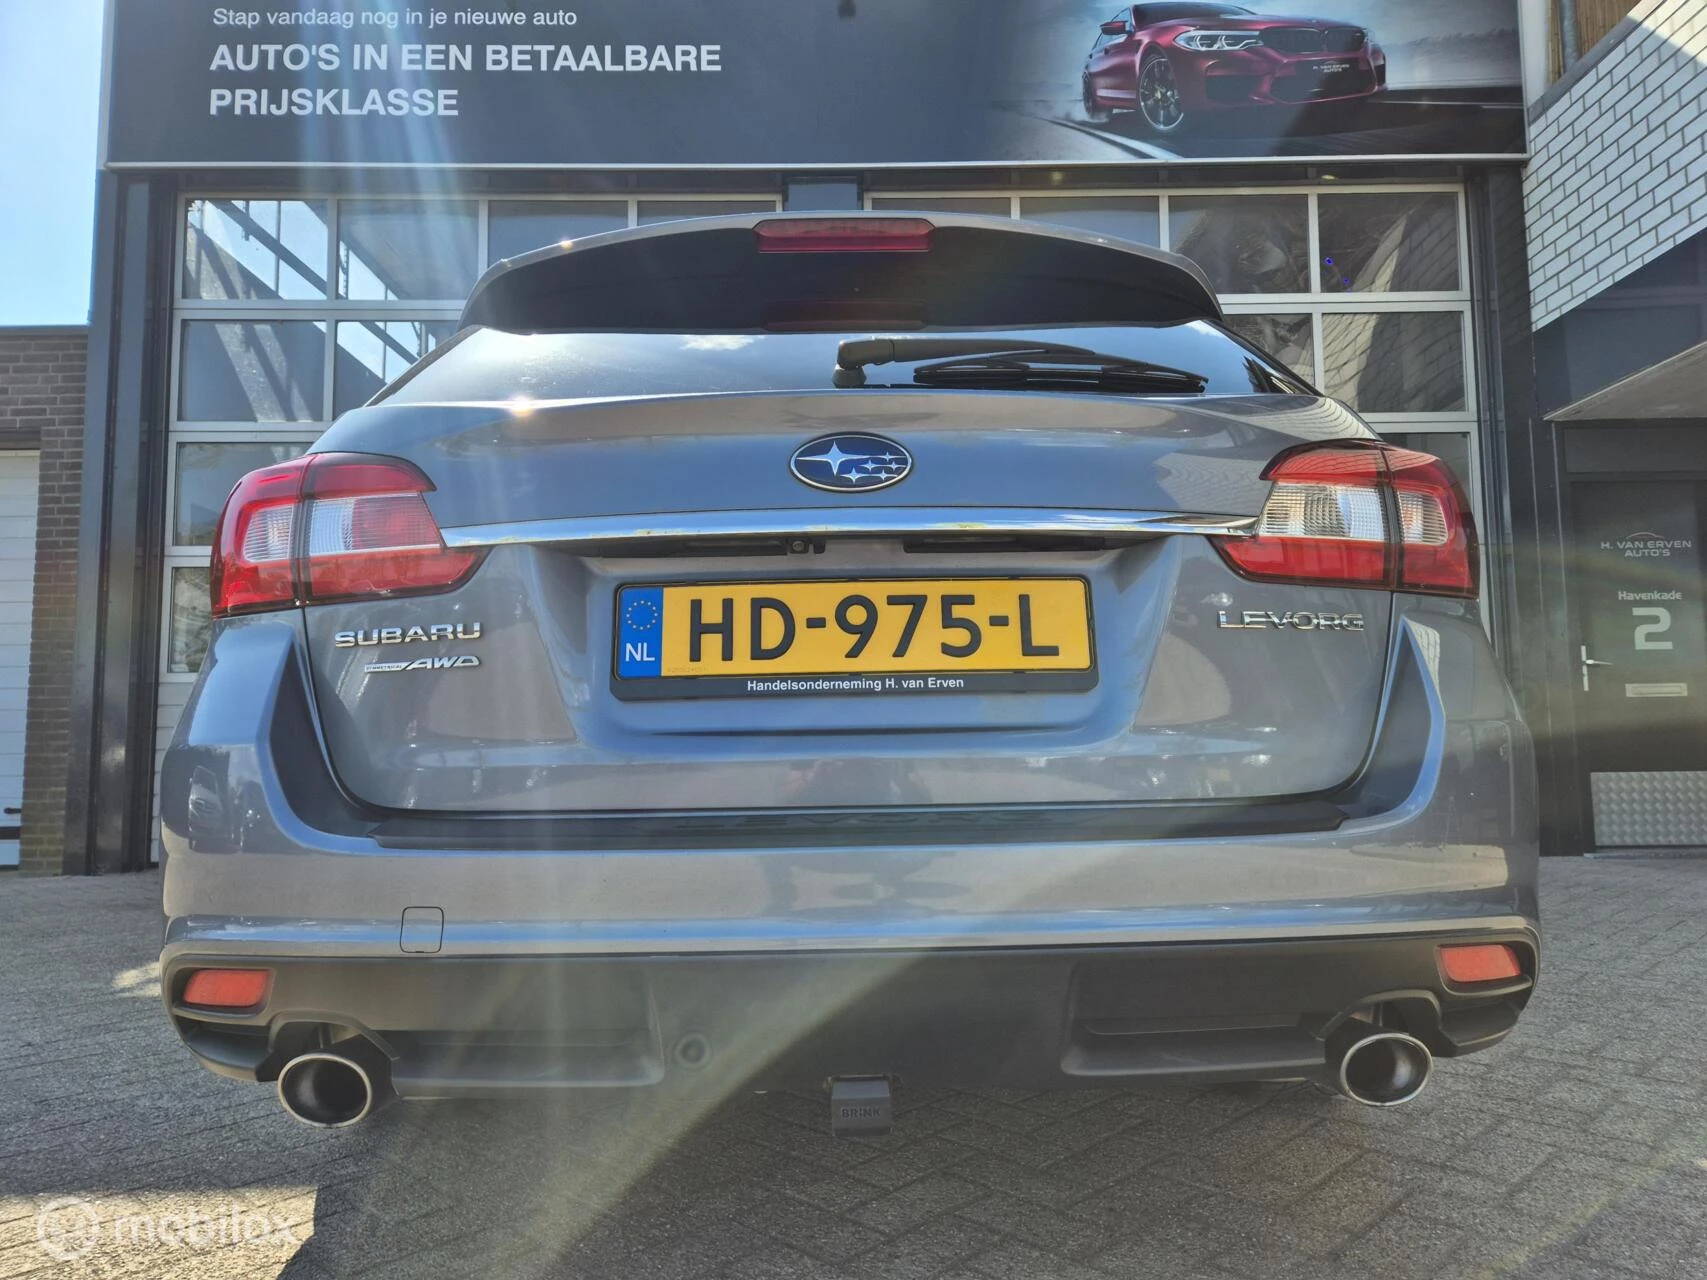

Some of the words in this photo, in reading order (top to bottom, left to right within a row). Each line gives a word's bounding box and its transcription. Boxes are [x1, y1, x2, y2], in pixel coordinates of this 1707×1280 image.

[213, 8, 261, 28] Stap
[266, 8, 355, 29] vandaag
[361, 11, 400, 29] nog
[405, 8, 423, 26] in
[428, 8, 447, 30] je
[454, 8, 526, 26] nieuwe
[533, 10, 577, 26] auto
[209, 43, 340, 72] AUTO'S
[353, 43, 388, 72] IN
[402, 43, 472, 72] EEN
[486, 43, 722, 72] BETAALBARE
[209, 88, 459, 117] PRIJSKLASSE
[1601, 541, 1613, 550] H.
[1617, 541, 1644, 549] VAN
[1647, 540, 1692, 549] ERVEN
[1624, 549, 1671, 557] AUTO'S
[1618, 590, 1683, 600] Havenkade
[689, 594, 1060, 662] HD-975-L
[1218, 611, 1364, 631] LEVORG
[1632, 607, 1674, 650] 2
[335, 622, 481, 647] SUBARU
[625, 642, 655, 662] NL
[406, 655, 480, 671] AWD
[747, 678, 881, 692] Handelsonderneming
[885, 677, 898, 689] H.
[901, 679, 925, 689] van
[928, 677, 964, 688] Erven
[841, 1107, 881, 1118] BRINK
